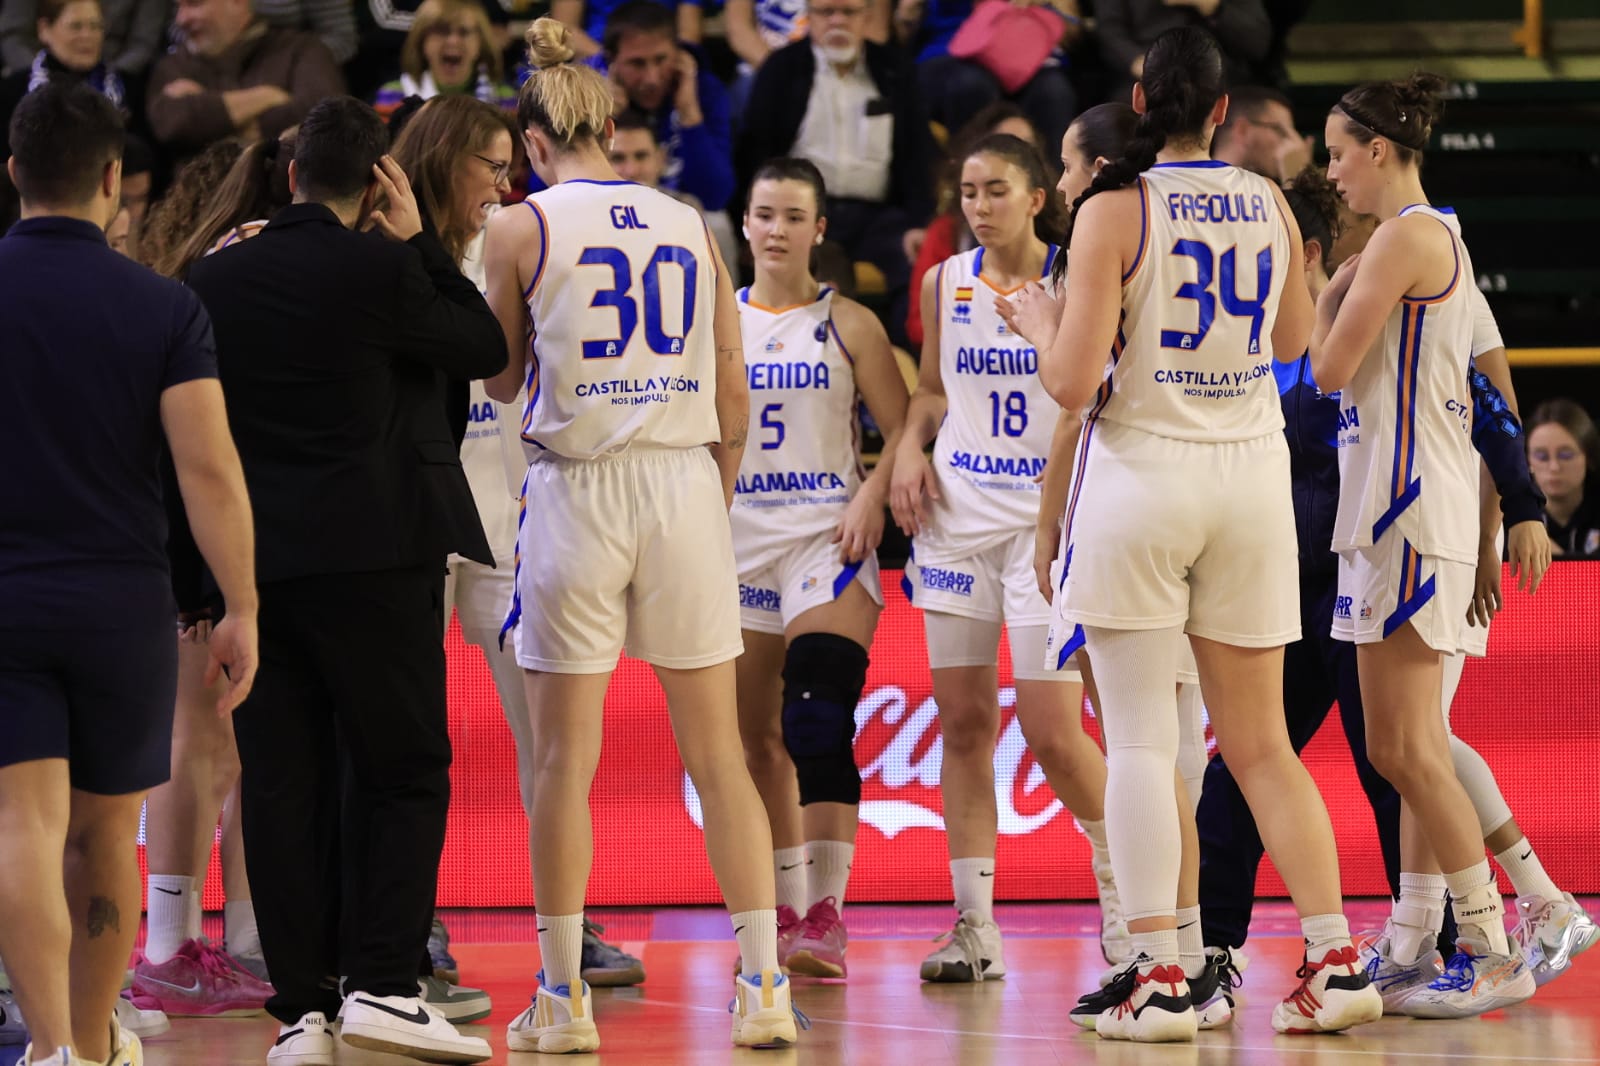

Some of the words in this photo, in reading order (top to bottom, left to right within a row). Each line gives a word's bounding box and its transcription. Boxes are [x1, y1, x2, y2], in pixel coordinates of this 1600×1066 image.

[1441, 133, 1480, 150] FILA
[610, 205, 649, 229] GIL
[1168, 193, 1267, 222] FASOULA
[575, 244, 698, 359] 30
[1160, 238, 1273, 355] 34
[956, 346, 1038, 375] AVENID
[575, 378, 656, 397] CASTILLA
[659, 376, 671, 391] Y
[745, 361, 829, 390] ENIDA
[1154, 369, 1230, 386] CASTILLA
[1233, 371, 1243, 386] Y
[611, 396, 629, 405] NOS
[630, 393, 670, 406] IMPULS
[1184, 388, 1202, 397] NOS
[989, 390, 1028, 437] 18
[760, 403, 785, 450] 5
[950, 450, 1047, 476] SALAMAN
[734, 471, 845, 494] ALAMANCA
[305, 1017, 322, 1026] NIKE
